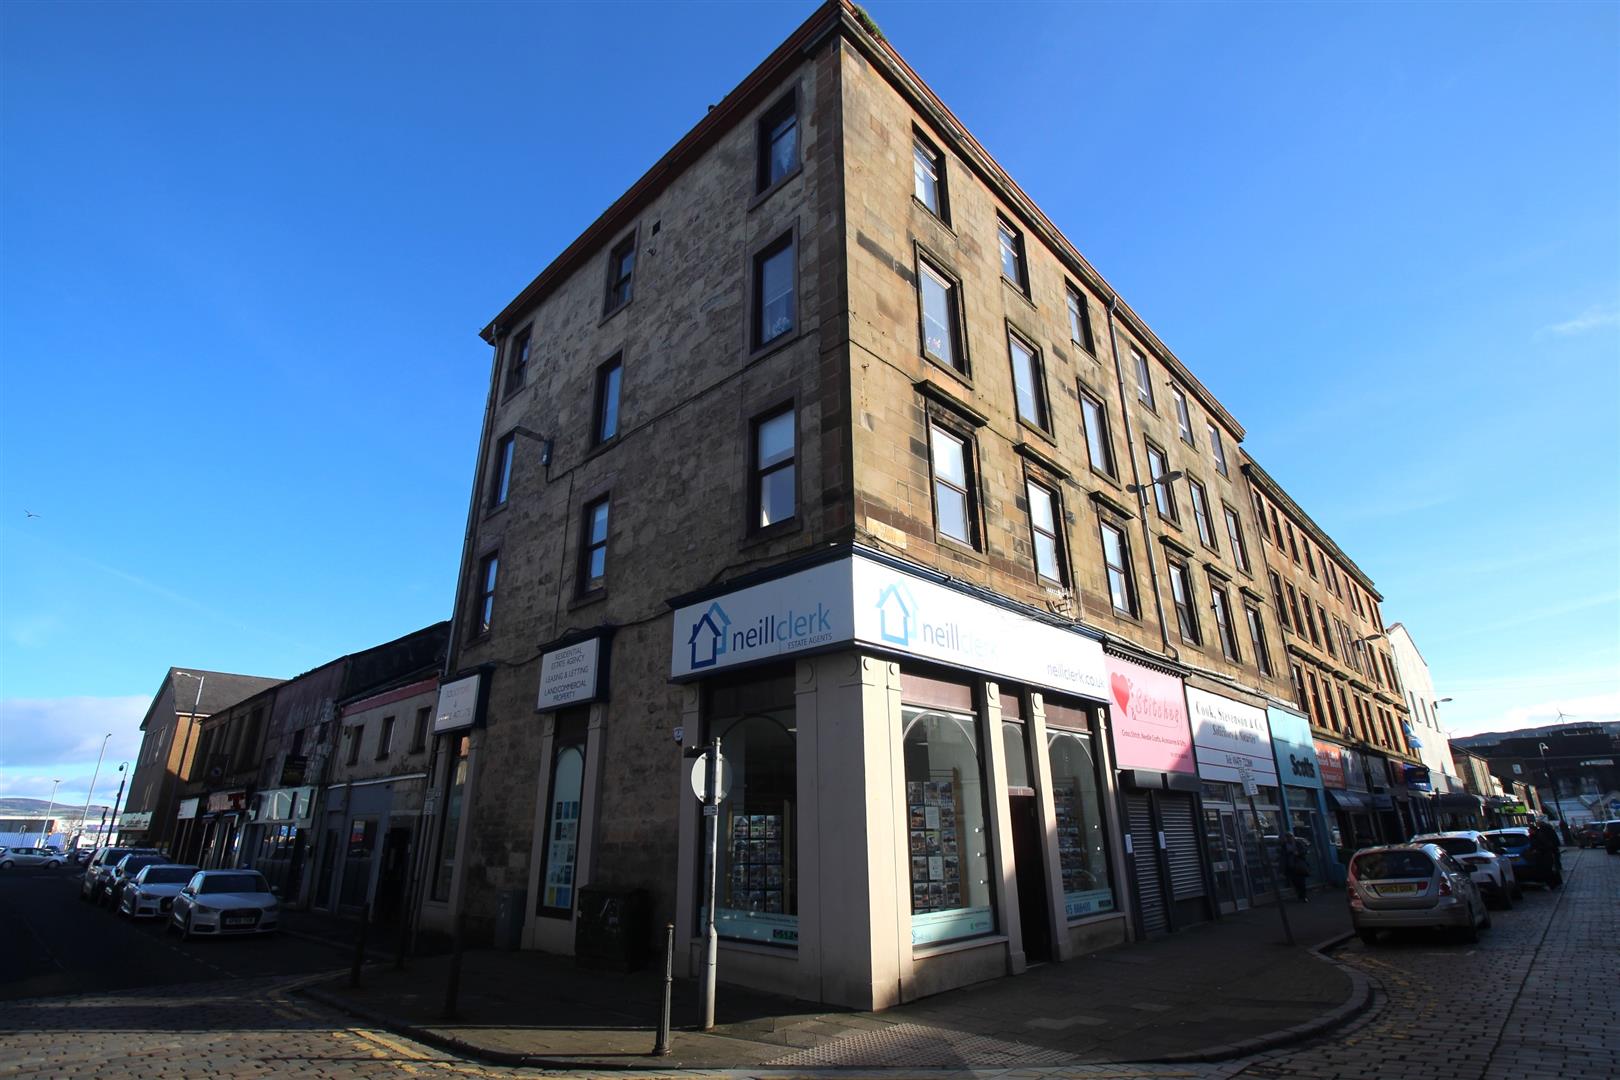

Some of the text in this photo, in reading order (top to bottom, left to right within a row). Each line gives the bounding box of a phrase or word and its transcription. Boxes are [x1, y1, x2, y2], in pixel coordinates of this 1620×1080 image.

[733, 602, 831, 651] neillclerk
[788, 633, 833, 649] ESTATE AGENTS
[554, 647, 583, 660] RESIDENTIAL
[551, 655, 585, 670] ESTATE AGENCY
[545, 672, 563, 683] LEASING
[568, 665, 589, 677] LETTING
[552, 691, 576, 702] PROPERTY
[1290, 753, 1315, 778] Scotts
